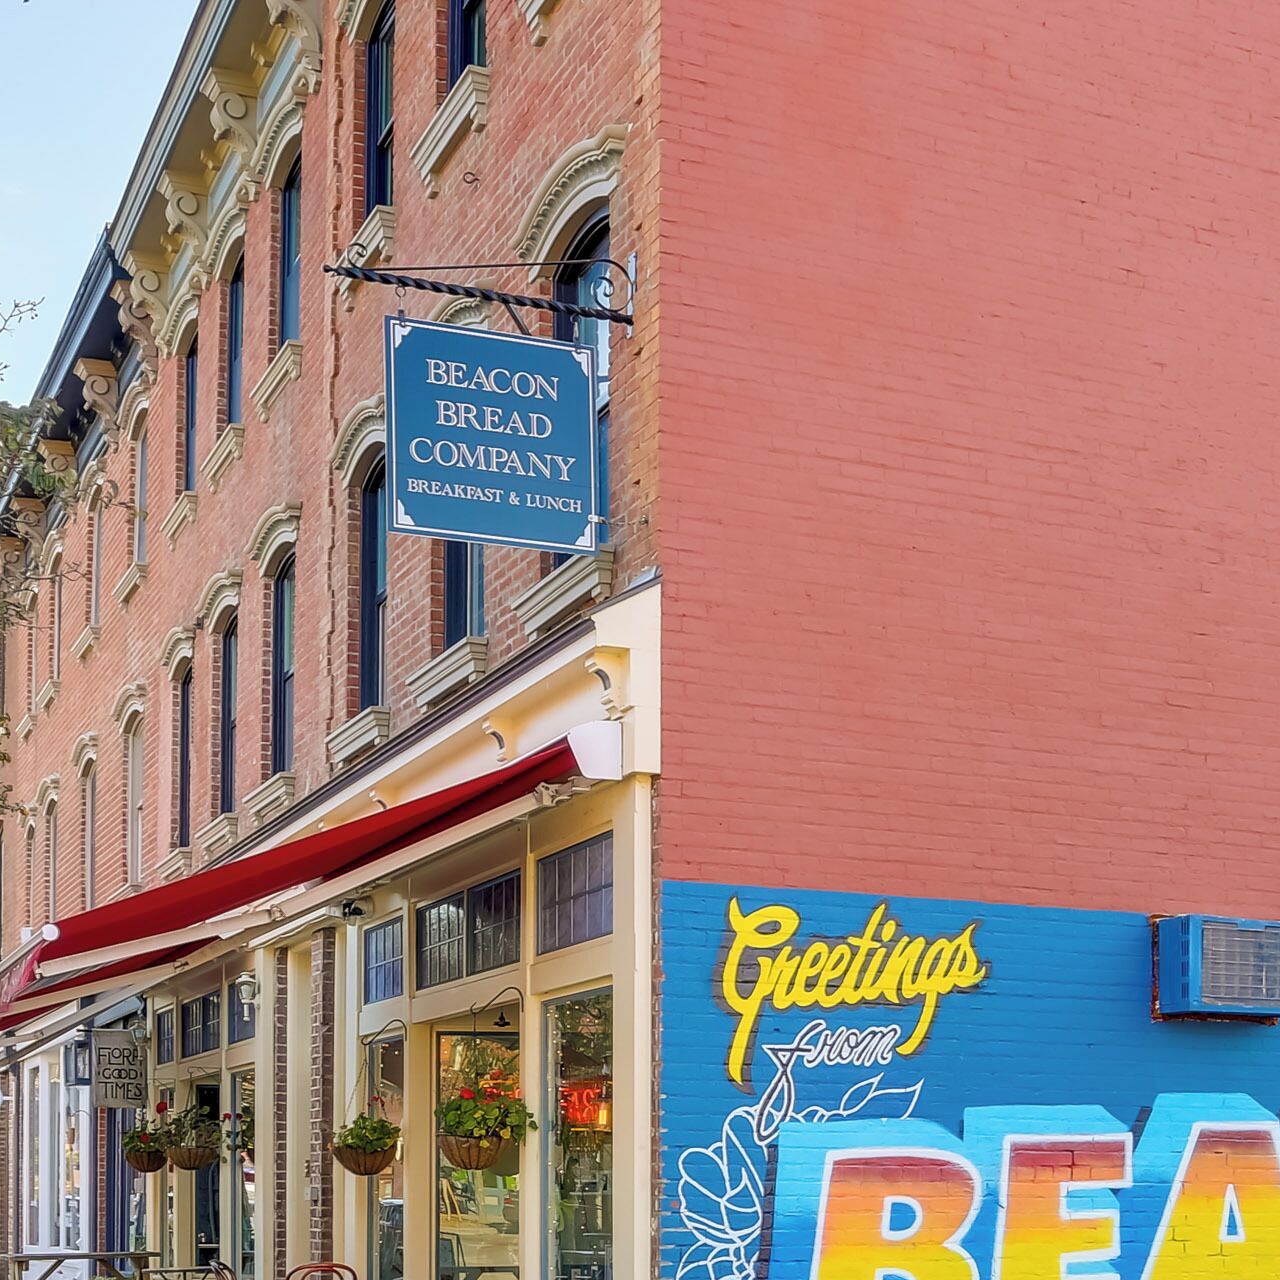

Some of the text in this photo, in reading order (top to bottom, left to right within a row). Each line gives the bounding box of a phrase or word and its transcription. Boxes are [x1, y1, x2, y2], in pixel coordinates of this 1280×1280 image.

[425, 358, 559, 401] BEACON
[436, 399, 552, 439] BREAD
[409, 437, 576, 482] COMPANY
[407, 478, 582, 514] BREAKFAST & LUNCH
[722, 896, 987, 1086] Greetings
[97, 1081, 143, 1100] TIMES
[102, 1068, 138, 1080] GOOD
[754, 1019, 901, 1144] from
